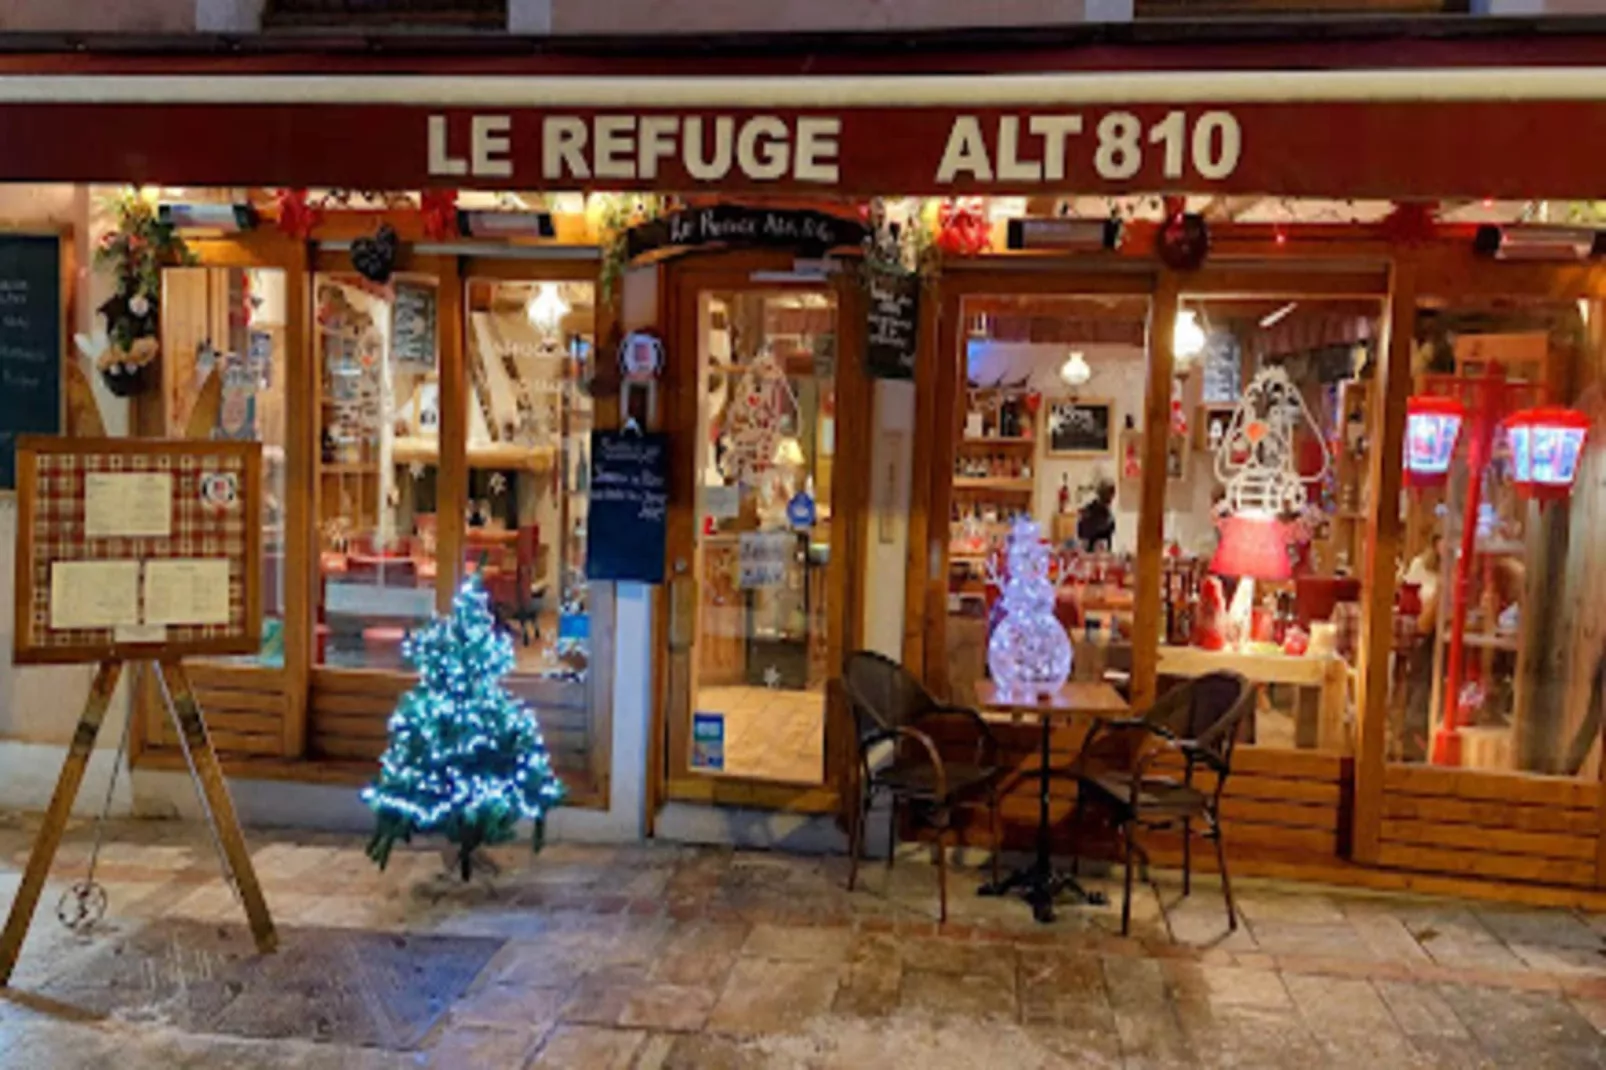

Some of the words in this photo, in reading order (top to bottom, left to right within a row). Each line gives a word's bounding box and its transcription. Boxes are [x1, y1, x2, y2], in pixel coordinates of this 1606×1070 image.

[428, 115, 512, 176] LE
[542, 115, 841, 183] REFUGE
[935, 114, 1083, 183] ALT
[1094, 111, 1241, 179] 810
